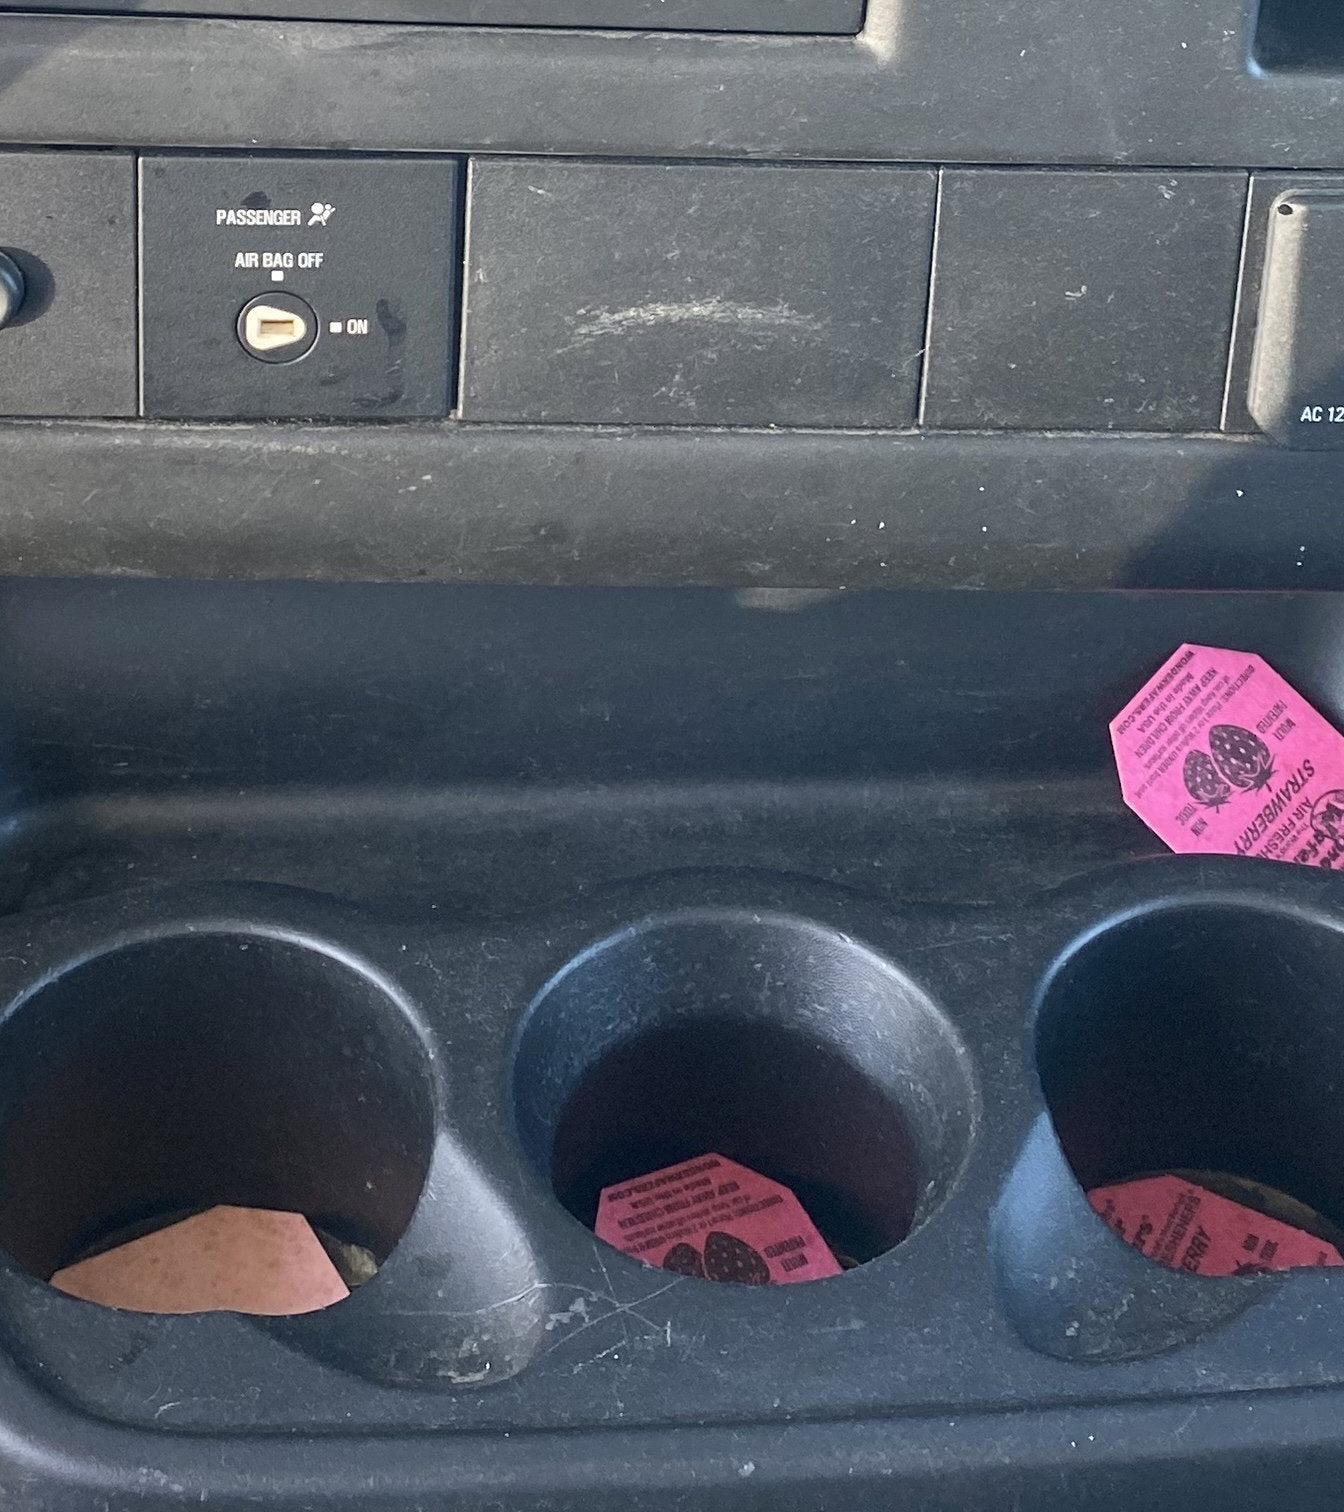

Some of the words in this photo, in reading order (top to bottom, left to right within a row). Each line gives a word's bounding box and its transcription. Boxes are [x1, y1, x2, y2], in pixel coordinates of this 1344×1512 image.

[215, 209, 302, 226] PASSENGER
[234, 252, 260, 269] AIR
[262, 252, 294, 269] BAG
[297, 252, 324, 269] OFF
[346, 318, 369, 335] ON
[1300, 406, 1323, 423] AC
[1199, 665, 1218, 688] KEEP
[1163, 691, 1176, 704] in
[1180, 682, 1203, 708] AWAY
[1151, 700, 1169, 717] the
[1162, 701, 1186, 726] FROM
[1135, 713, 1157, 734] USA
[1232, 757, 1316, 858] STRAWBERRY
[1290, 795, 1315, 821] AIR
